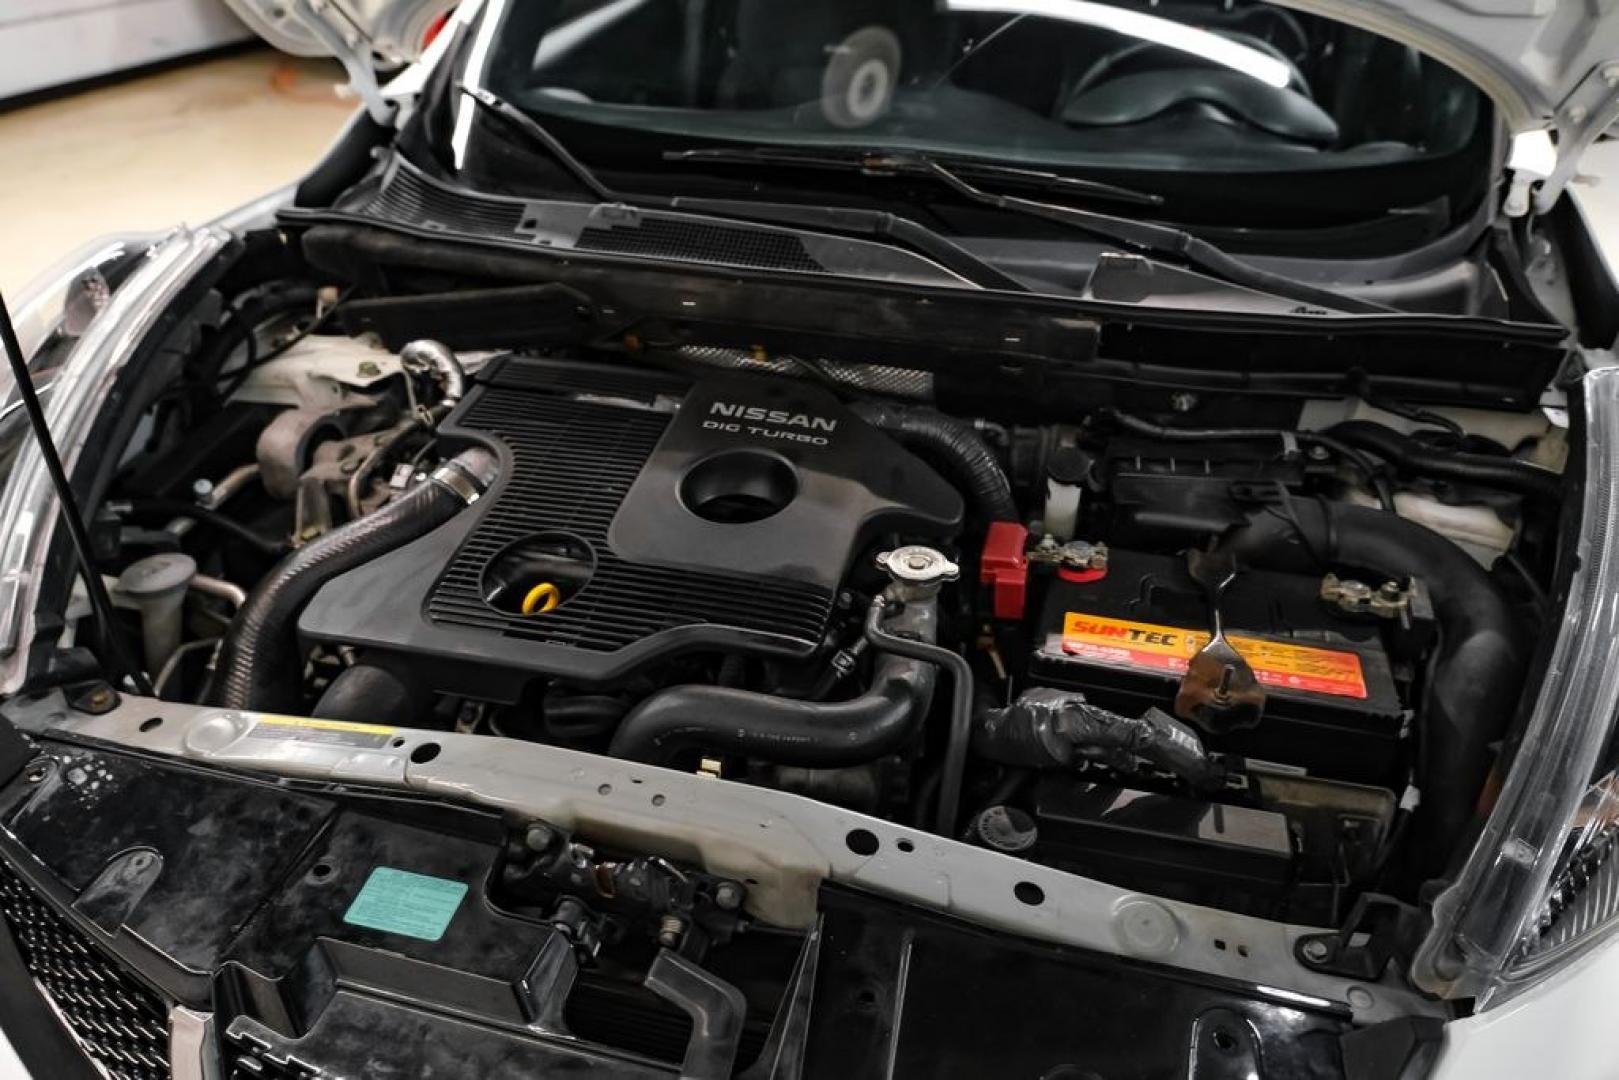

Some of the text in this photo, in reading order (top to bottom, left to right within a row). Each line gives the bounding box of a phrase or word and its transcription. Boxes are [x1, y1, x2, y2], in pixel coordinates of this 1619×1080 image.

[710, 402, 837, 432] NISSAN
[702, 421, 829, 445] DIG TURBO
[1072, 621, 1178, 646] SUNTEC
